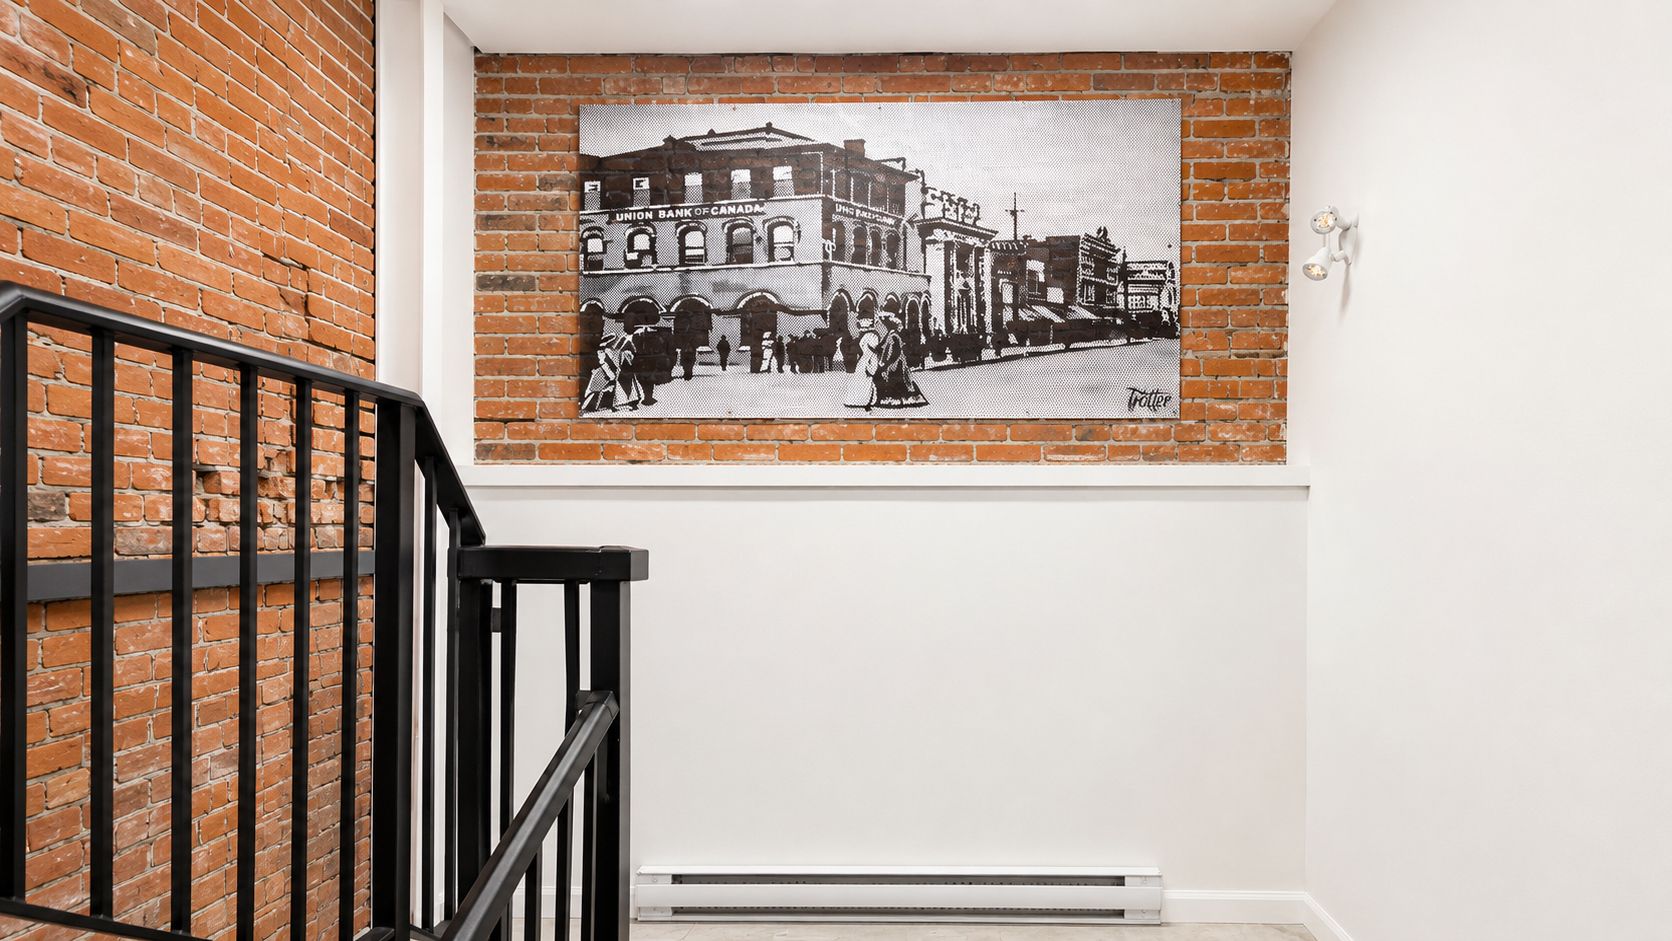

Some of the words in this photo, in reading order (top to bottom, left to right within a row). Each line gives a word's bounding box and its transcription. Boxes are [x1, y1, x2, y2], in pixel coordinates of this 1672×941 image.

[615, 211, 653, 222] UNION
[658, 208, 693, 219] BANK
[694, 207, 710, 216] OF
[1126, 387, 1172, 411] Trotter
